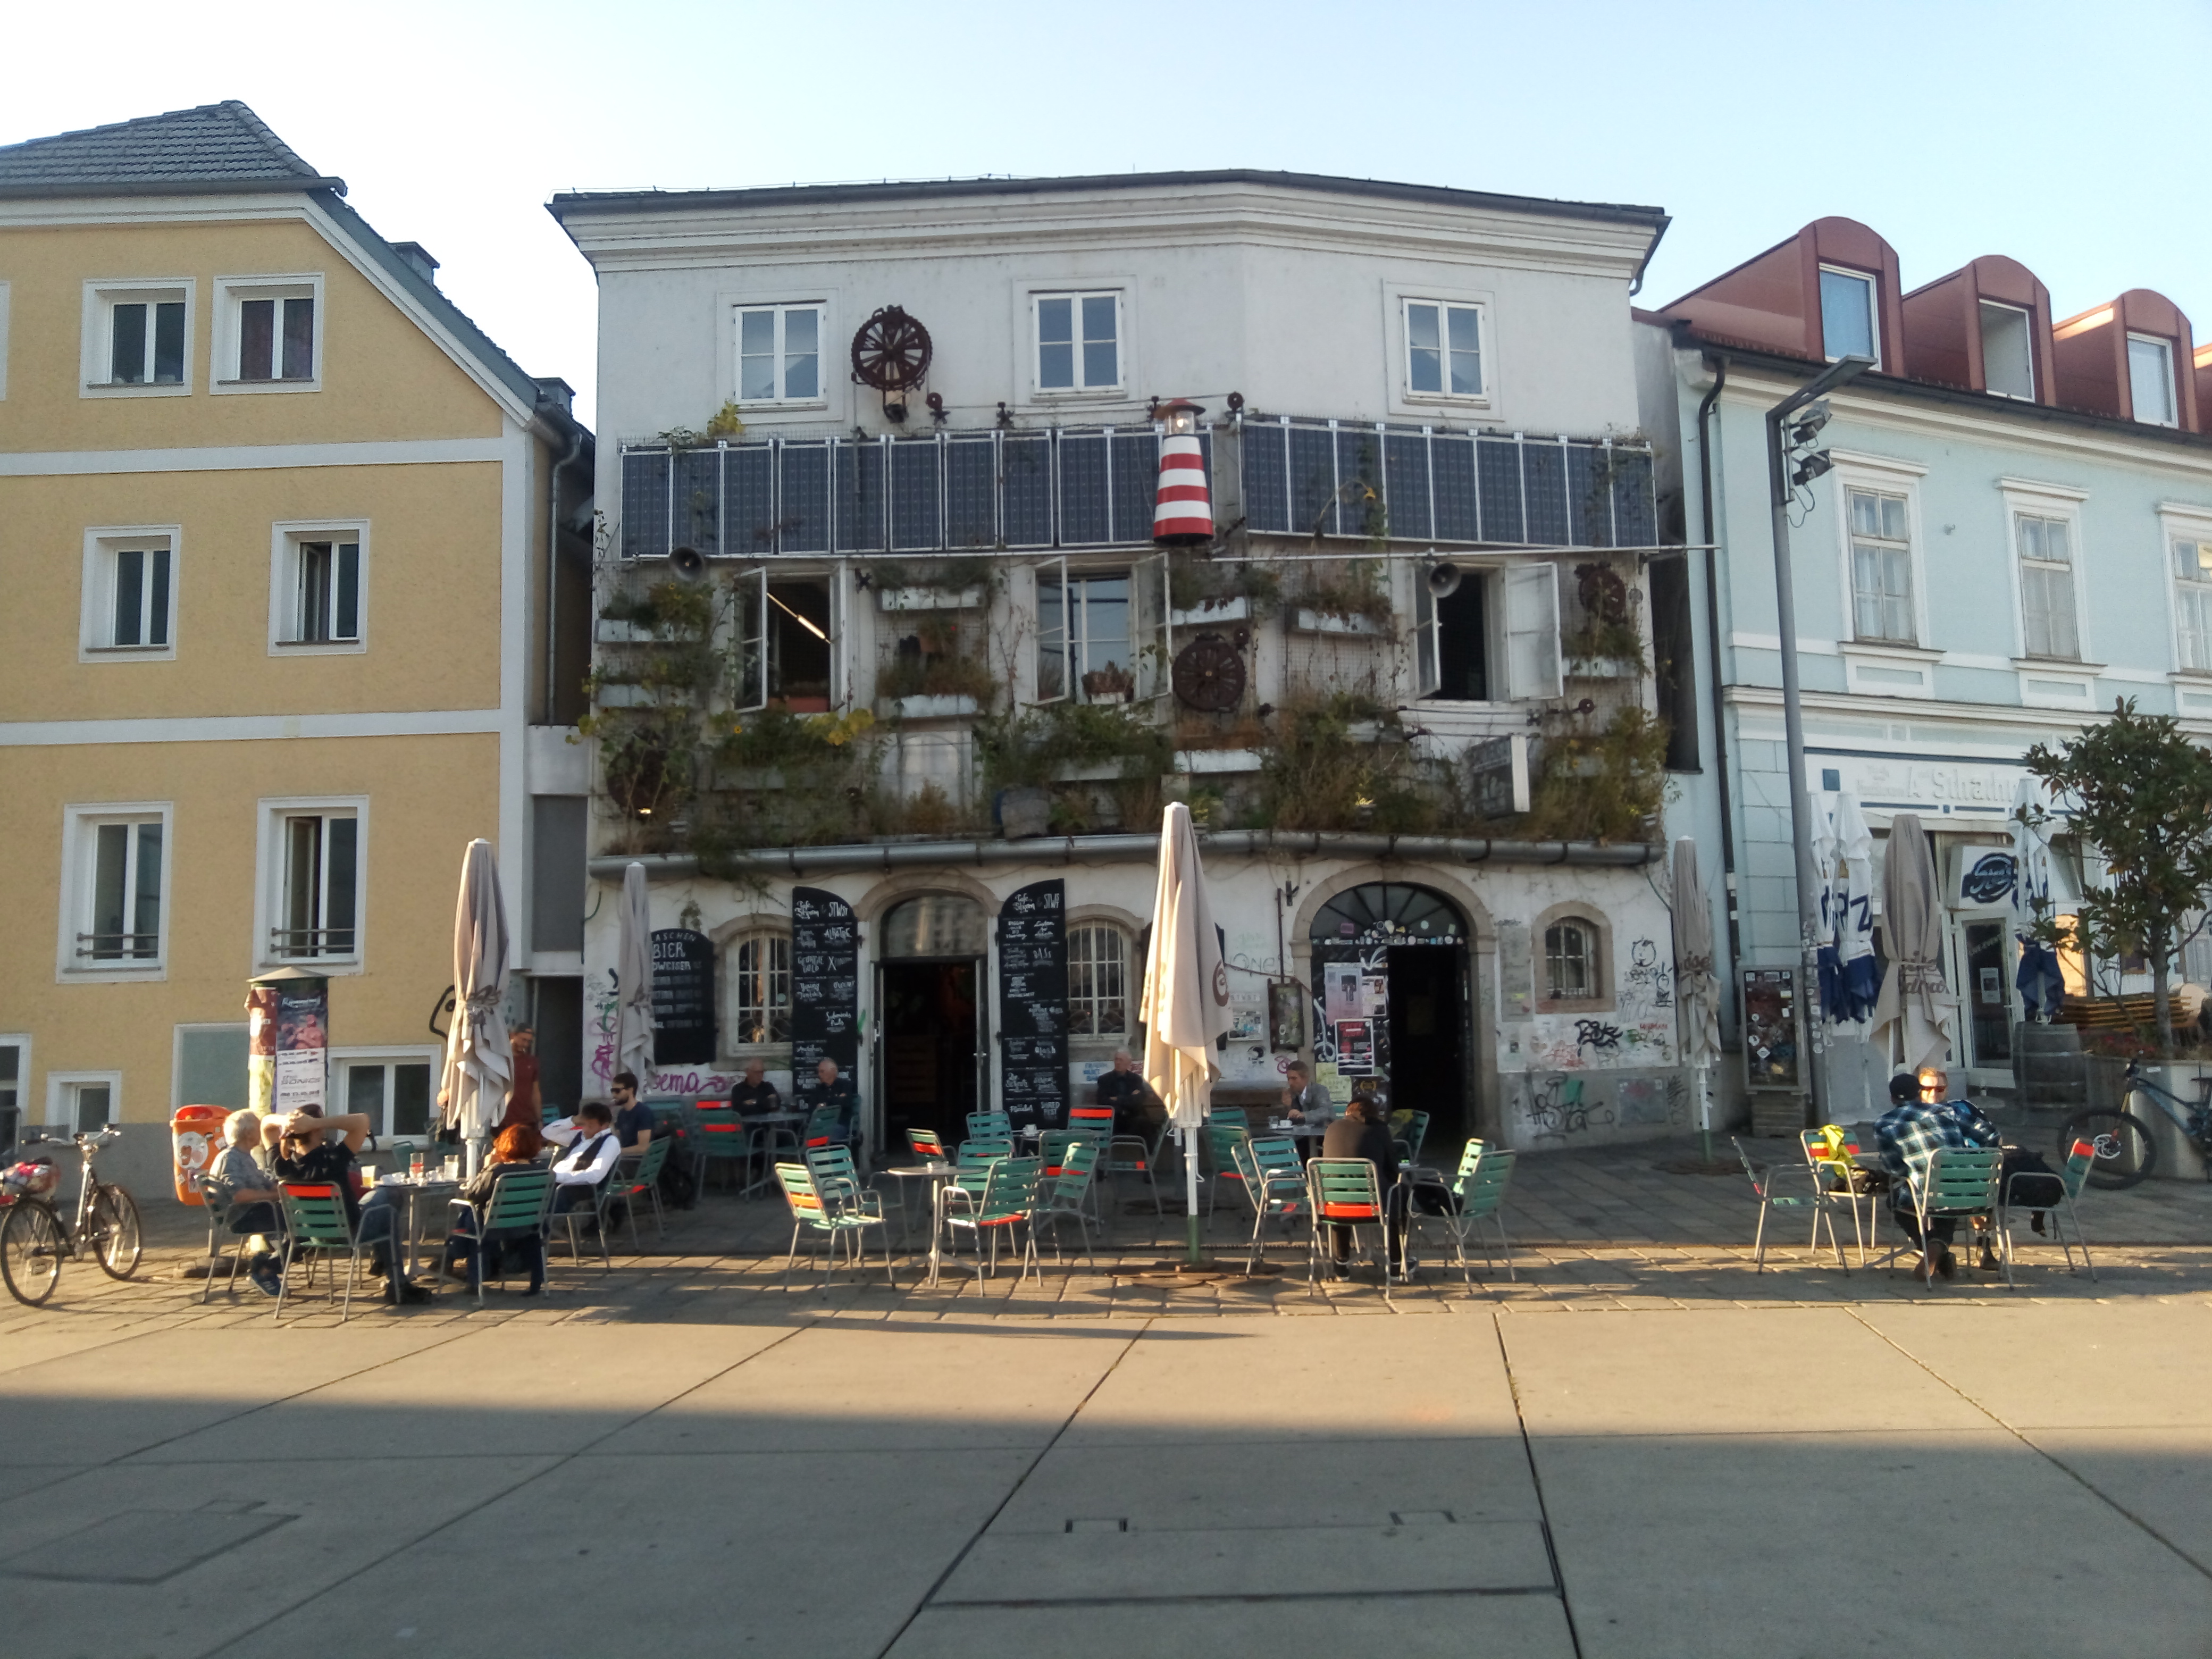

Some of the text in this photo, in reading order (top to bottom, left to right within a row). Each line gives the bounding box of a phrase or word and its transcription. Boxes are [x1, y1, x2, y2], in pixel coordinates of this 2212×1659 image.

[656, 932, 697, 942] ASCHEN
[652, 942, 686, 959] BIER
[652, 961, 691, 971] DWEISER
